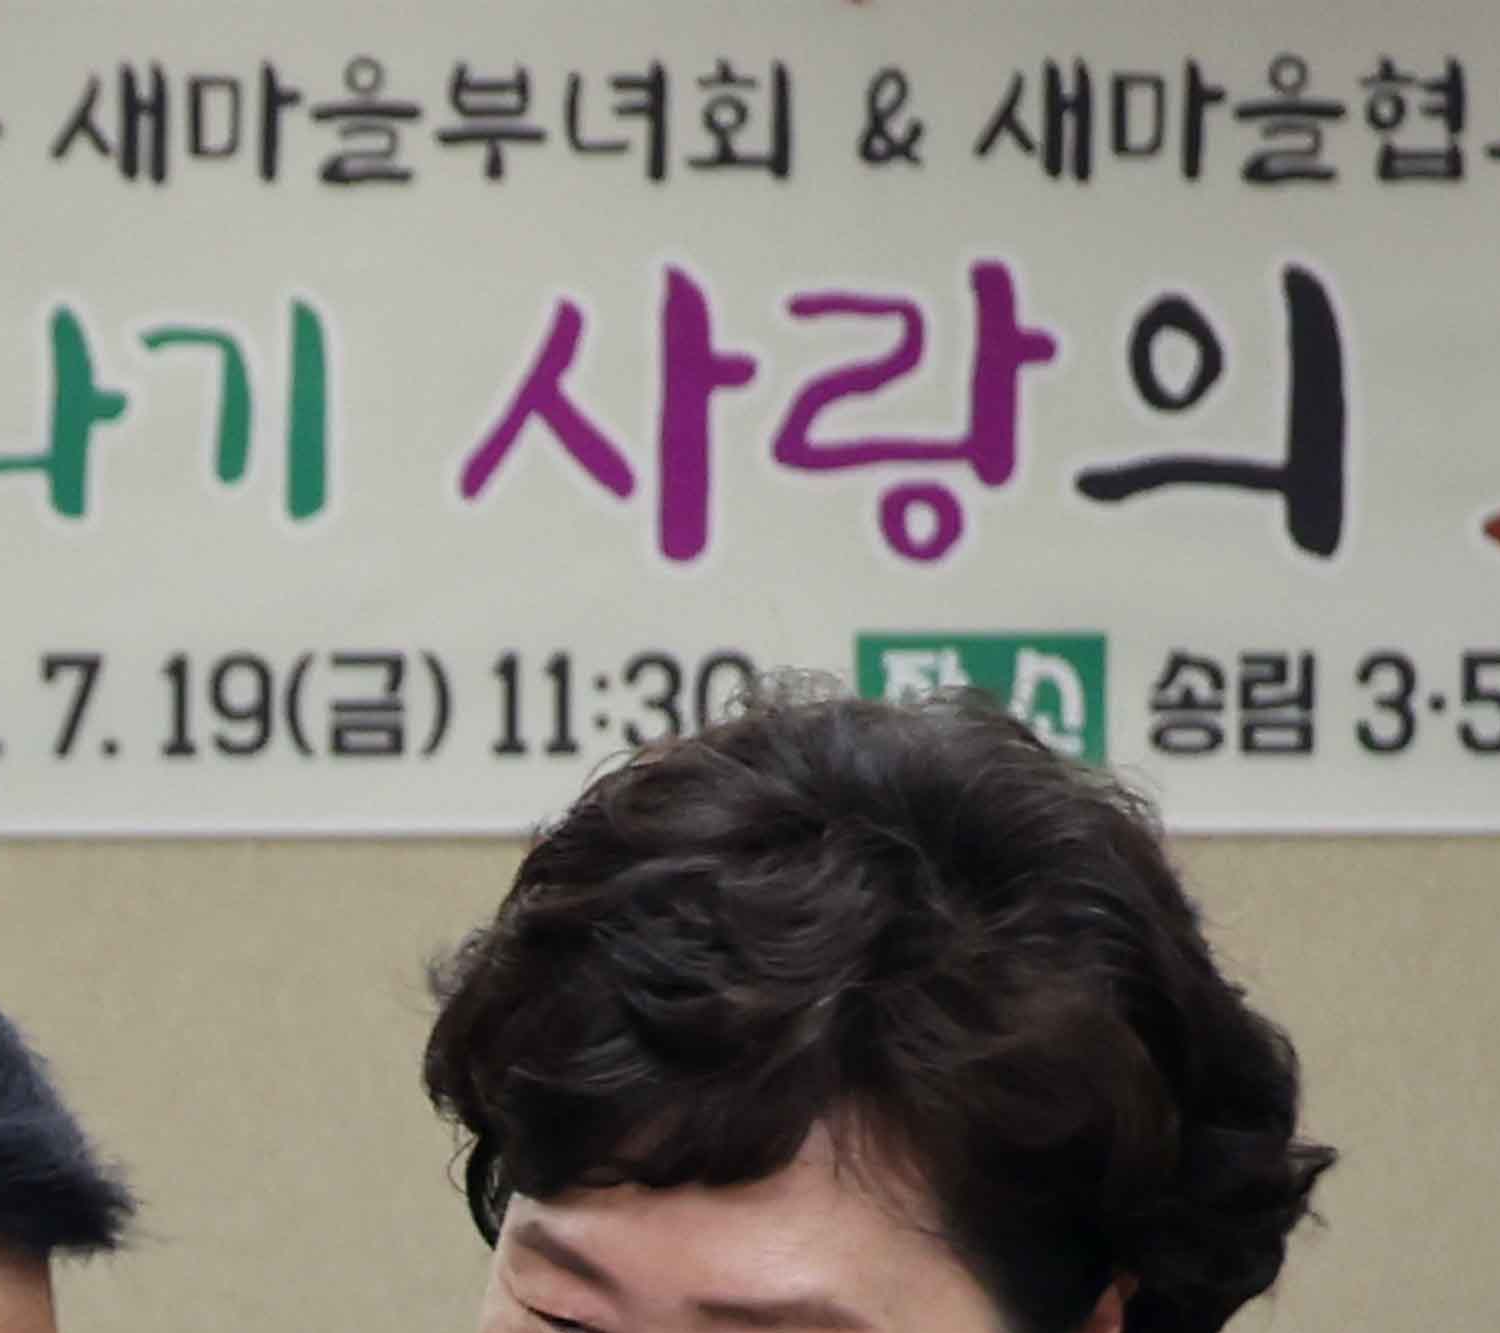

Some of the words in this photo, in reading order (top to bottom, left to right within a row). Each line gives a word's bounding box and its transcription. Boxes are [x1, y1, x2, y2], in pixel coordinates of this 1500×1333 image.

[50, 56, 793, 187] 새마을부녀회
[856, 67, 924, 166] &
[458, 258, 1346, 563] 사랑의
[40, 653, 119, 760] 7.
[161, 651, 453, 759] 19(금)
[490, 649, 757, 757] 11:30
[1148, 650, 1316, 756] 송림
